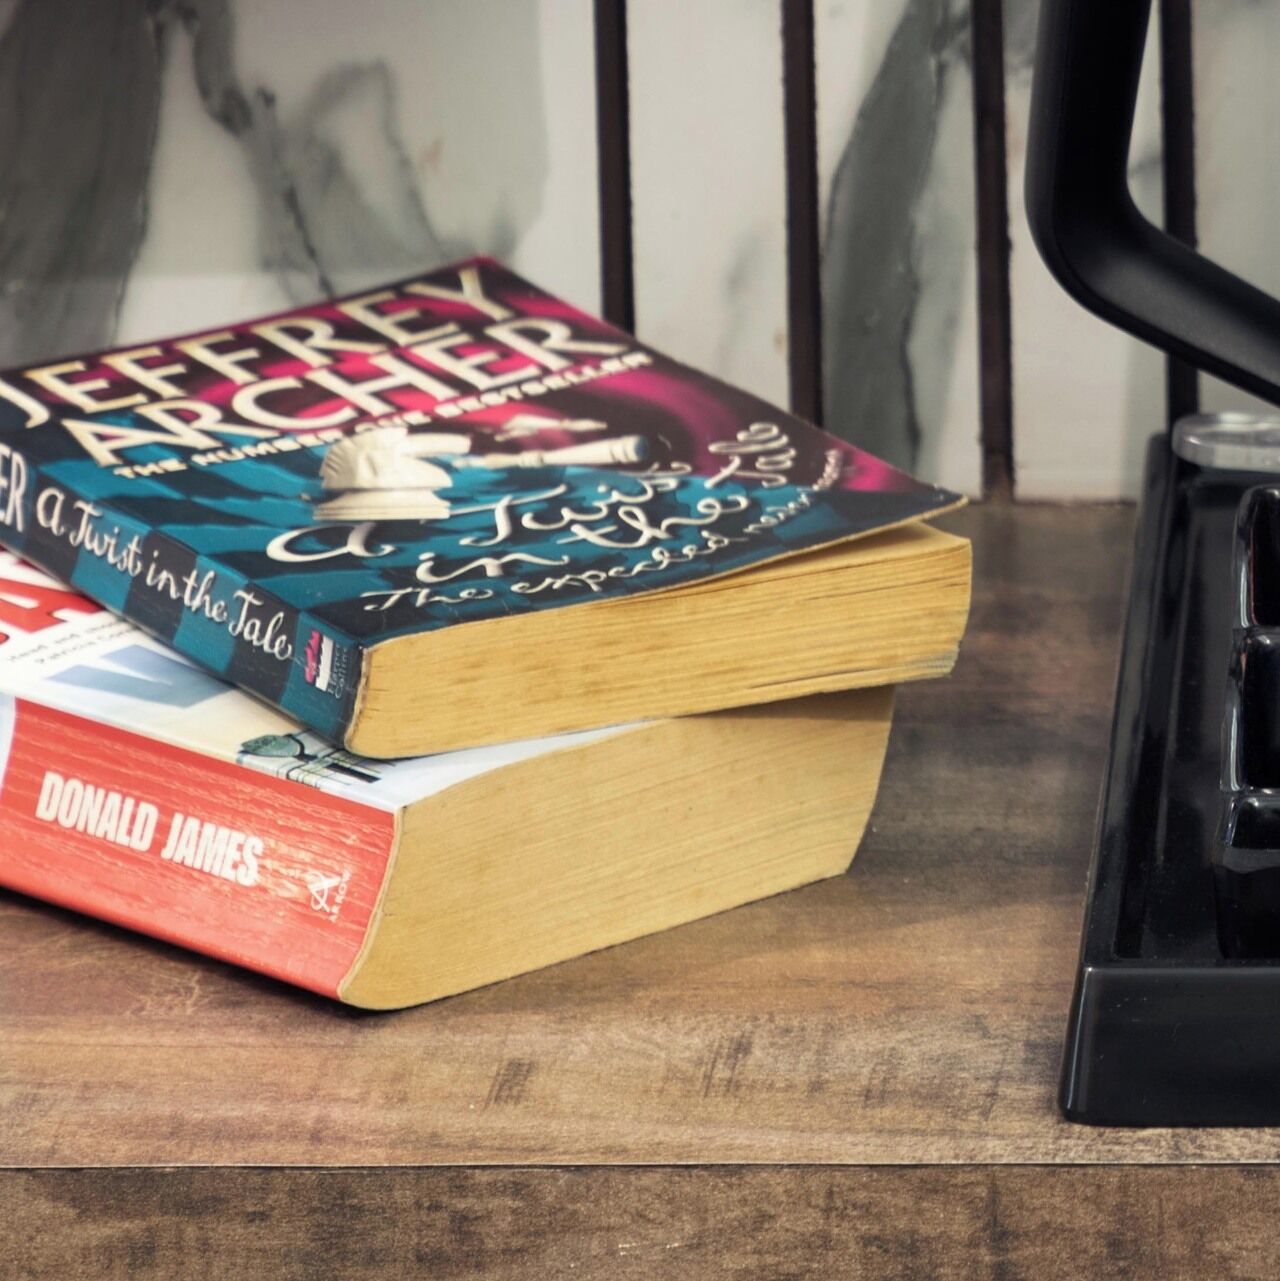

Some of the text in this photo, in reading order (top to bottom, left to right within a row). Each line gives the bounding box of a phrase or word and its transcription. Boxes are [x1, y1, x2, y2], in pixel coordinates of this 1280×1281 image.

[0, 266, 515, 428] JEFFREY
[60, 317, 630, 468] ARCHER
[113, 456, 188, 479] THE
[190, 428, 343, 467] NUMBER
[433, 351, 652, 419] BESTSELLER
[68, 500, 143, 577] Twist
[145, 551, 179, 600] in
[180, 568, 228, 623] the
[228, 589, 293, 661] Tale
[360, 586, 494, 611] The
[415, 552, 571, 584] in
[556, 494, 749, 549] the
[35, 770, 266, 887] DONALD JAMES
